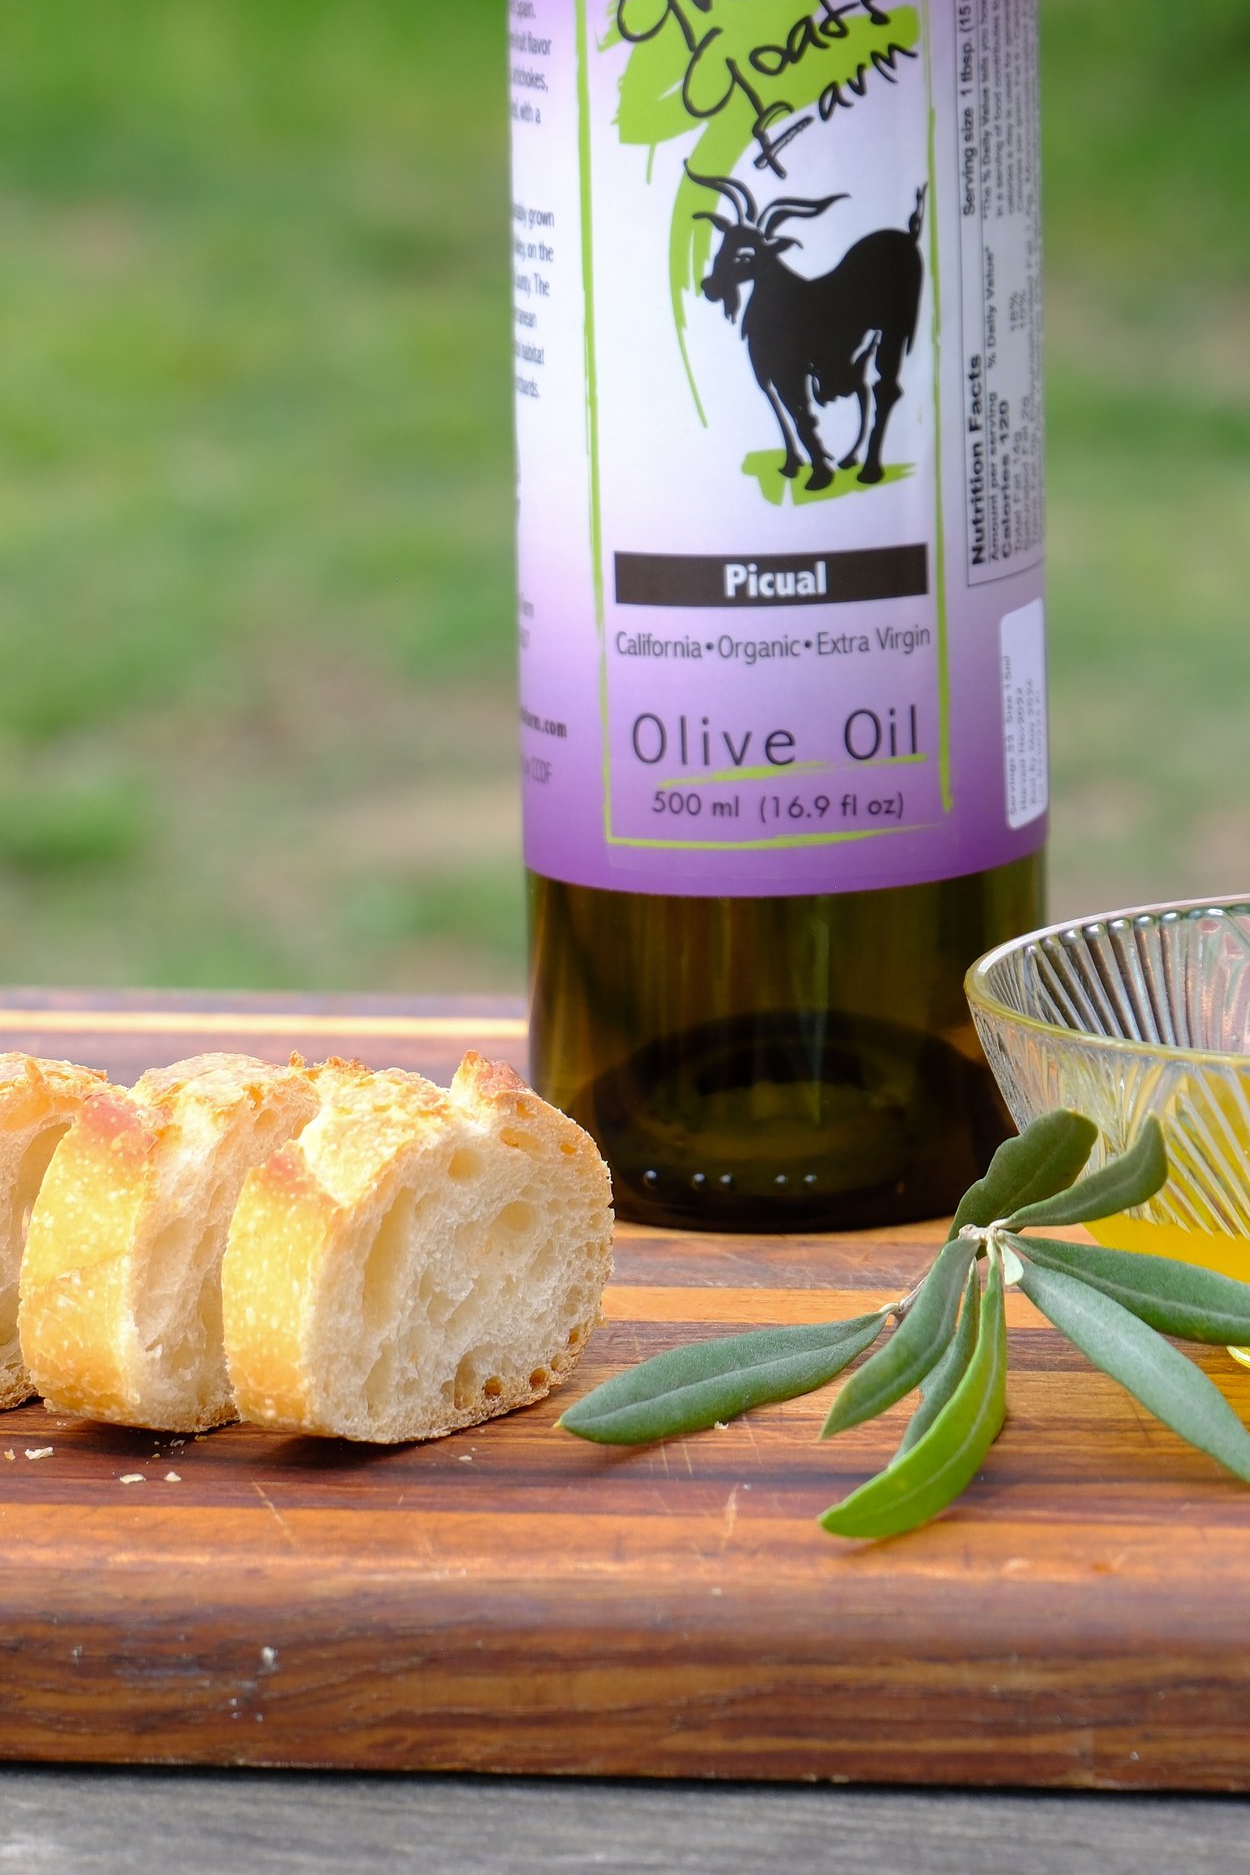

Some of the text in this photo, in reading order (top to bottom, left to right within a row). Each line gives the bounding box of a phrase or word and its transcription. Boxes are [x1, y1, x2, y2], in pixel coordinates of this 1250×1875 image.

[959, 5, 974, 32] (15
[528, 32, 551, 55] flavor
[959, 38, 974, 82] tbsp.
[752, 41, 919, 179] Farm
[960, 89, 972, 97] 1
[536, 106, 541, 124] a
[962, 108, 973, 142] size
[962, 147, 977, 216] Serving
[529, 207, 554, 230] grown
[528, 242, 536, 258] on
[539, 242, 554, 262] the
[534, 273, 550, 296] The
[967, 355, 986, 565] Nutrition Facts
[999, 400, 1011, 559] Calories 120
[724, 561, 827, 597] Picual
[616, 624, 931, 664] California Organic Extra Virgin
[632, 704, 918, 767] Olive Oil
[652, 791, 905, 825] 500 ml (16.9 fl oz)
